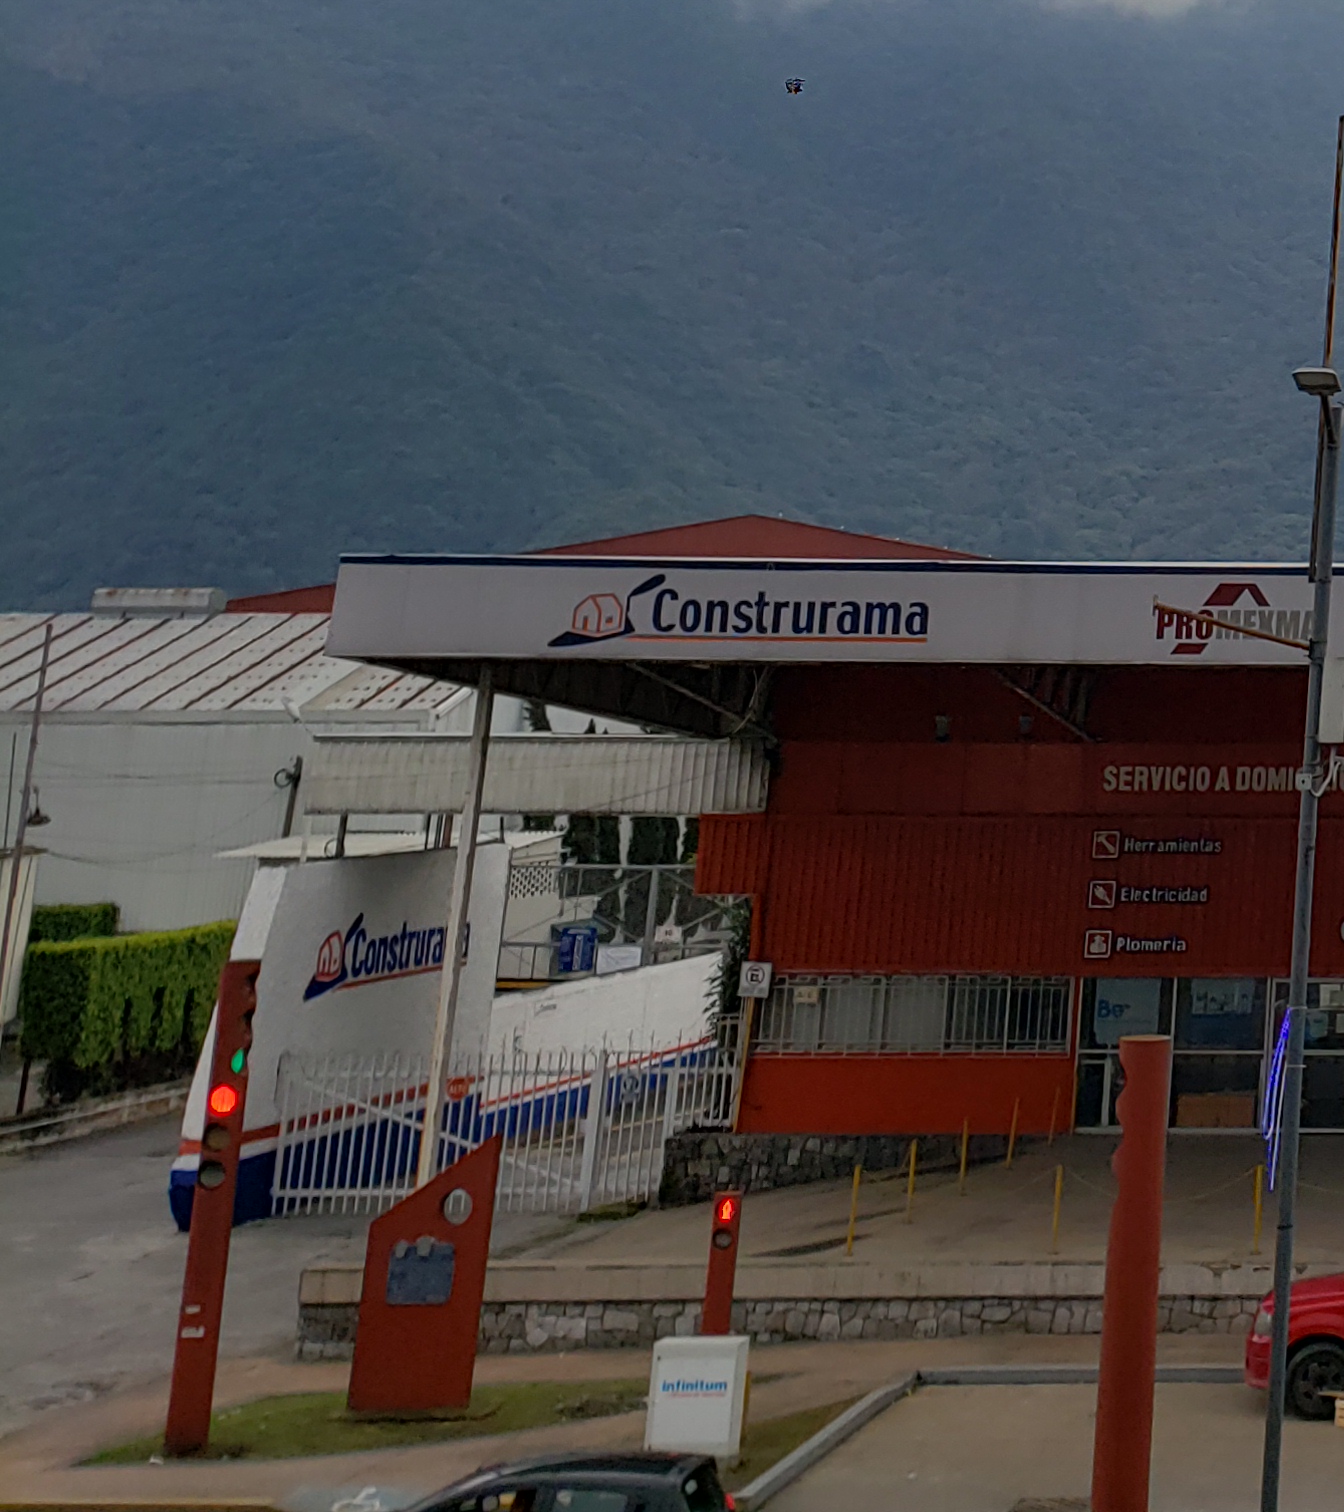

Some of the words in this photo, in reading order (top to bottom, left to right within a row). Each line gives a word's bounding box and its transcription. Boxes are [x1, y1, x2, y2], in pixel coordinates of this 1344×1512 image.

[653, 588, 929, 635] Construrama
[1103, 766, 1209, 792] SERVICIO
[1214, 766, 1231, 792] A
[1124, 837, 1222, 853] Herramientas
[1121, 886, 1207, 902] Electricidad
